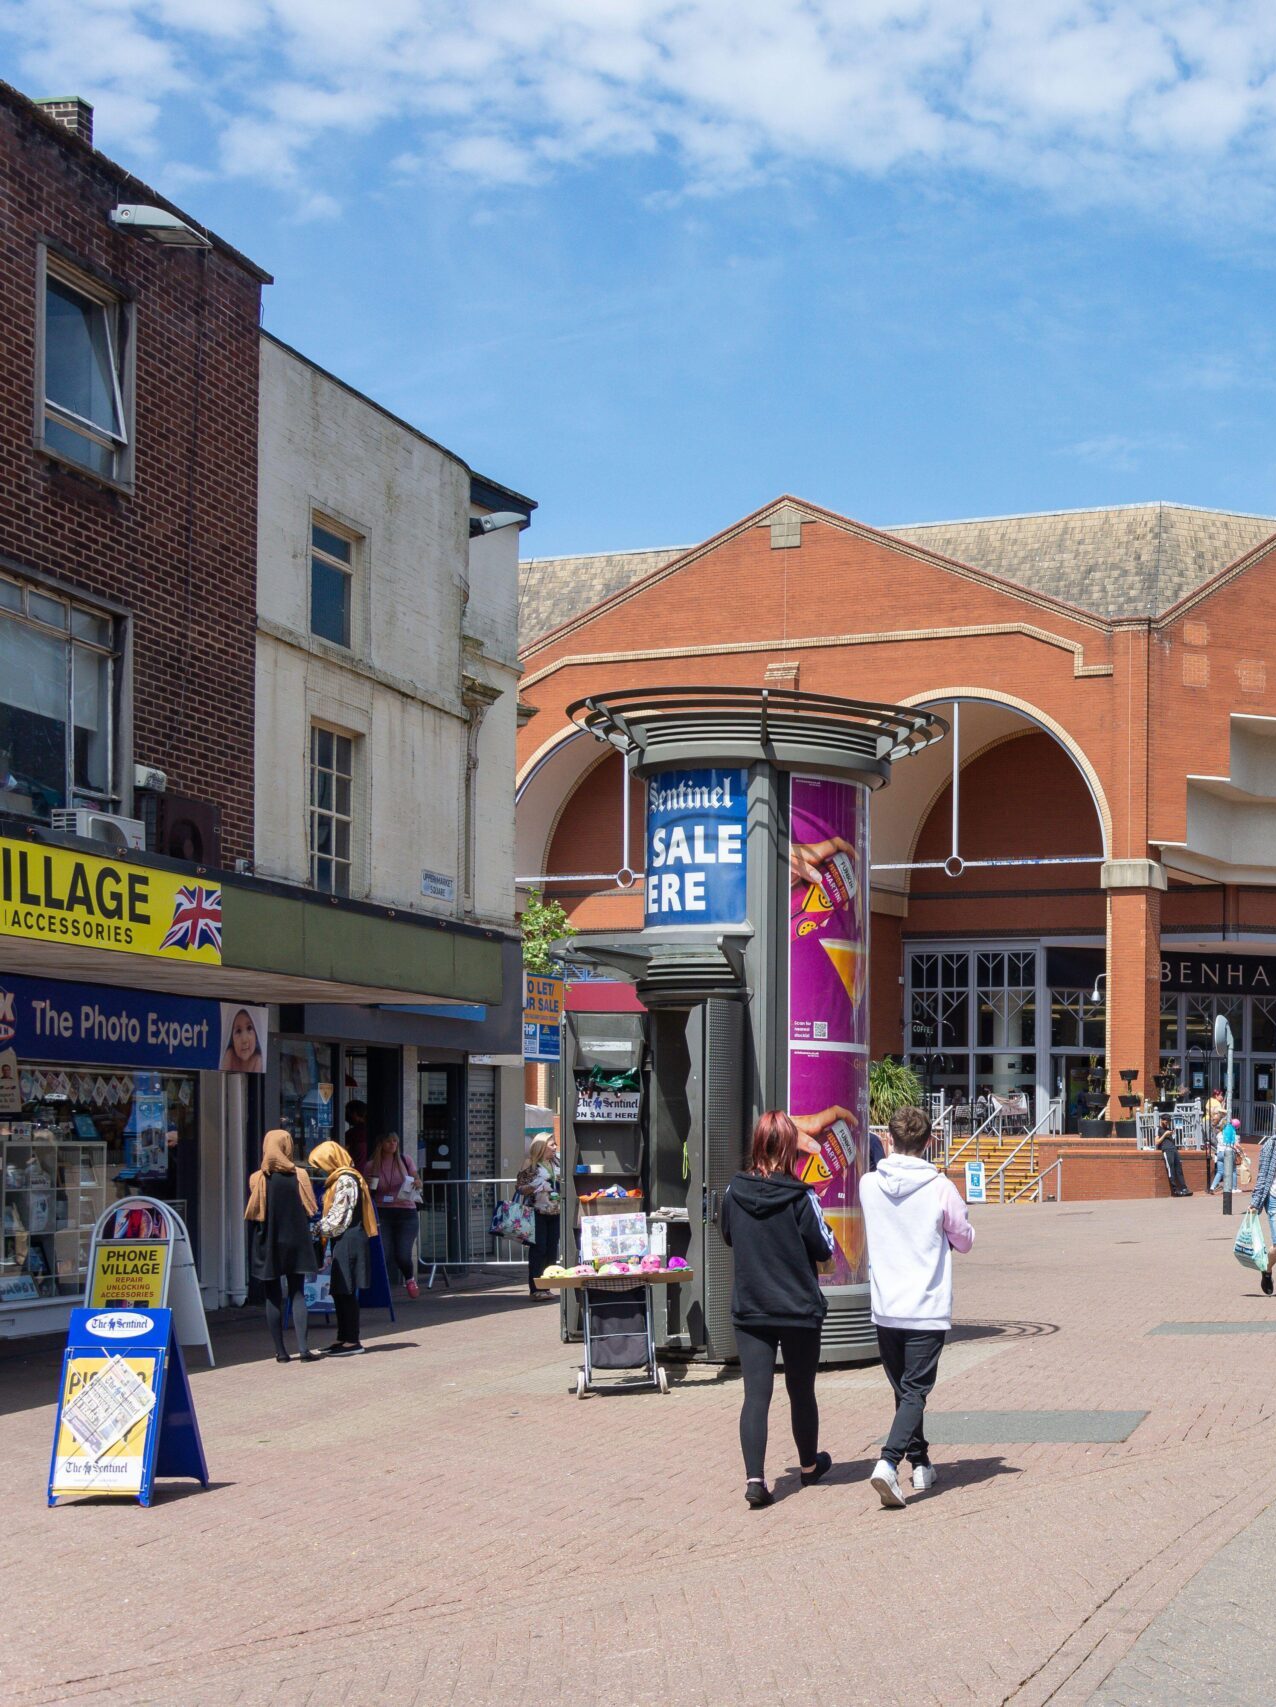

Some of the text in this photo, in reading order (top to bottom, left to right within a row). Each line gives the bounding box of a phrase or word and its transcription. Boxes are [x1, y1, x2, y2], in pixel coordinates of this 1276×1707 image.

[649, 776, 734, 814] Sentinel
[652, 825, 742, 868] SALE
[2, 847, 151, 925] ILLAGE
[430, 885, 446, 896] SQUARE
[11, 909, 134, 945] ACCESSORIES
[538, 998, 559, 1013] SALE
[32, 999, 209, 1055] The Photo Expert
[576, 1097, 639, 1109] The Sentinel
[839, 1129, 852, 1155] FUNKIN
[823, 1140, 841, 1172] MARTINI
[106, 1250, 158, 1262] PHONE
[101, 1263, 160, 1275] VILLAGE
[91, 1319, 148, 1329] The Sentinel
[65, 1462, 128, 1473] The Sentinel
